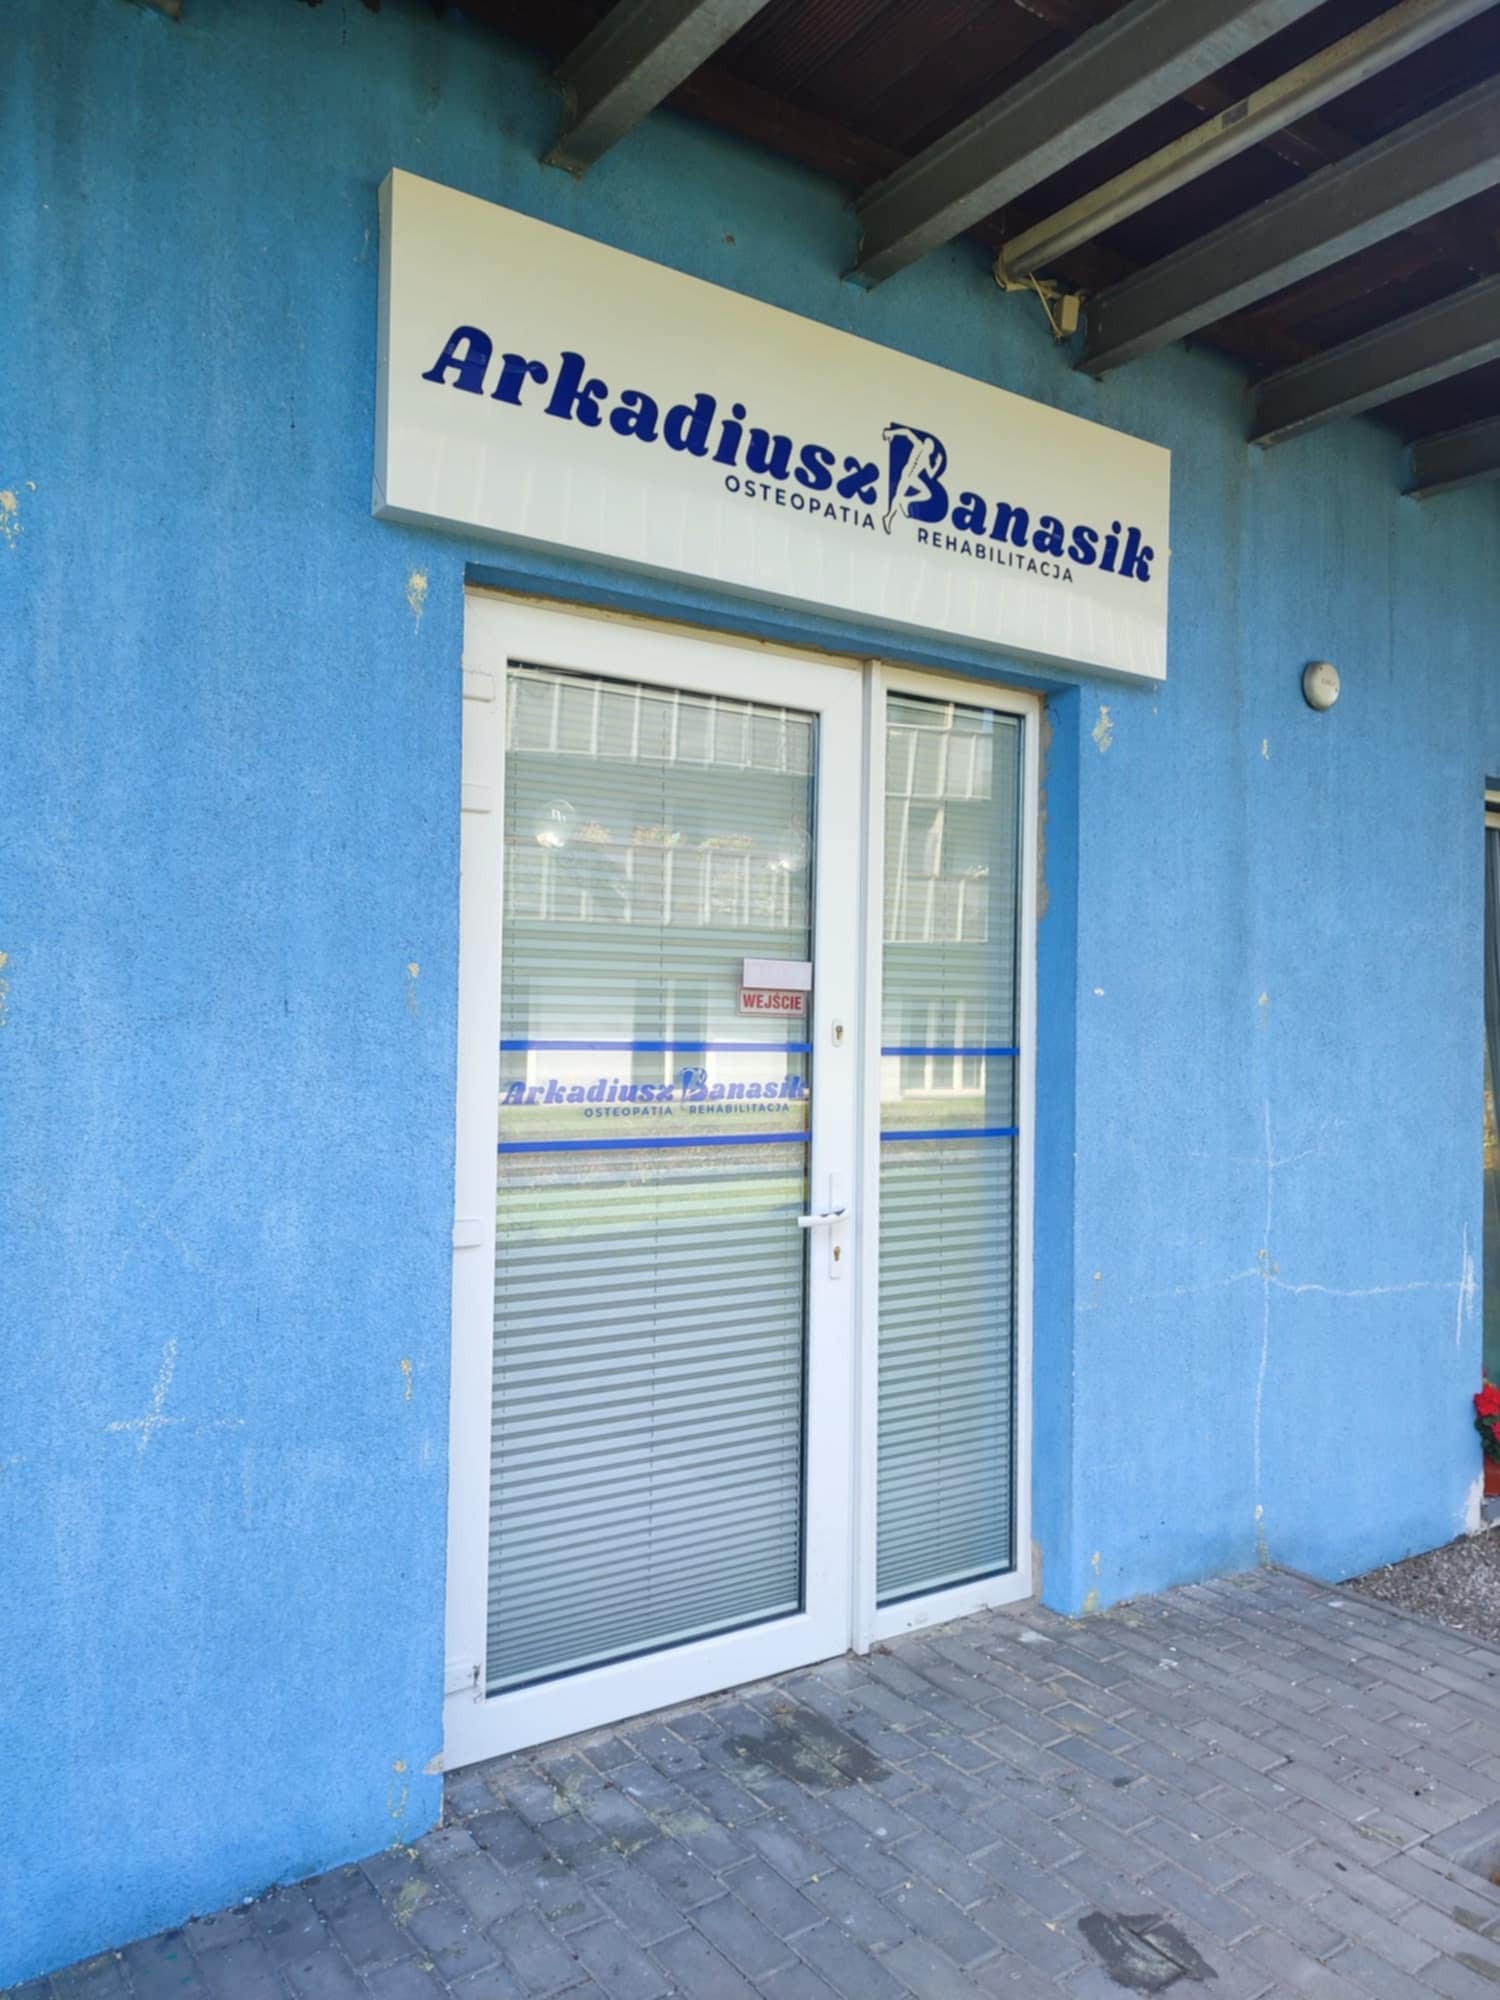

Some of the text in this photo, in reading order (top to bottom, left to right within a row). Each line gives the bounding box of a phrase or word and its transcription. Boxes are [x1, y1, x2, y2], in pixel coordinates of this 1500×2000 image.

[421, 324, 1155, 583] Arkadiusz Banasik
[724, 475, 1075, 583] OSTEOPATIA REHABILITACJA
[742, 992, 802, 1010] WEJŚCIE
[501, 1079, 674, 1105] Arkadiusz
[583, 1102, 790, 1118] OSTEOPATIA REHABILITACJA
